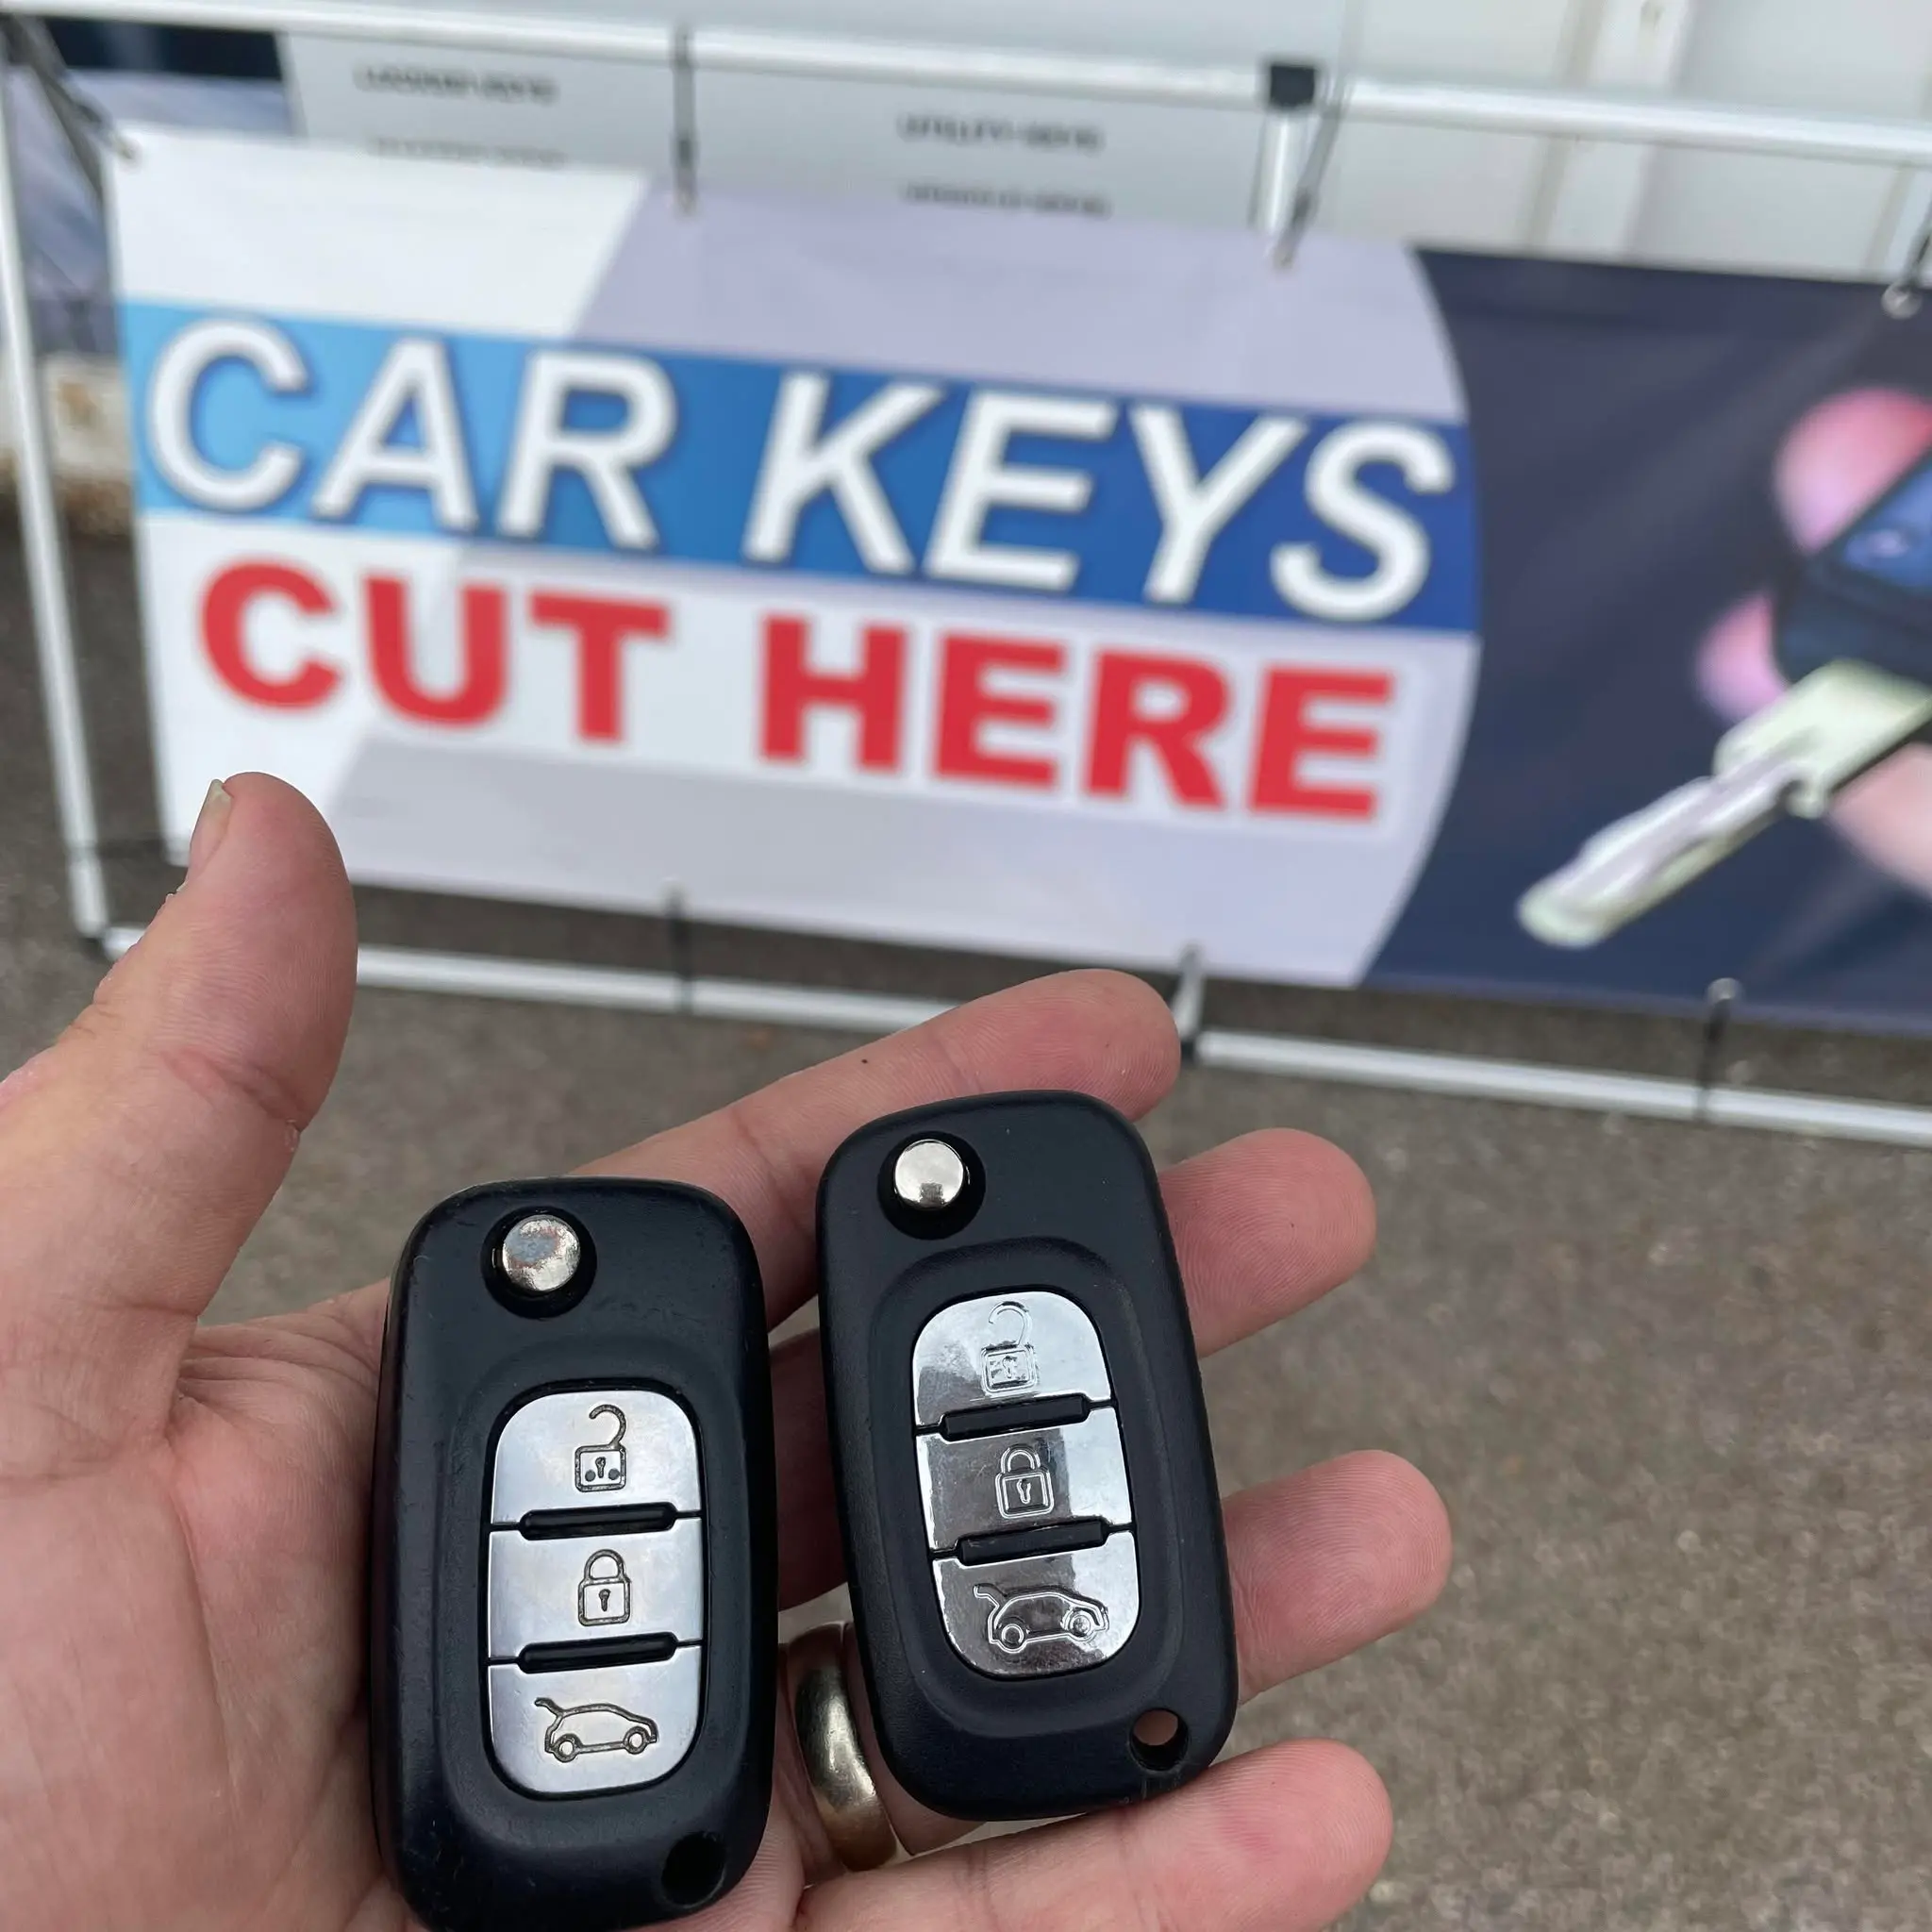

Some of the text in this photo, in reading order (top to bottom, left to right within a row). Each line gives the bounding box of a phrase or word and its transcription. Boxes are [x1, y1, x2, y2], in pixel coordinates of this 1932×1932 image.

[147, 318, 1456, 622] CAR KEYS
[200, 560, 1393, 820] CUT HERE
